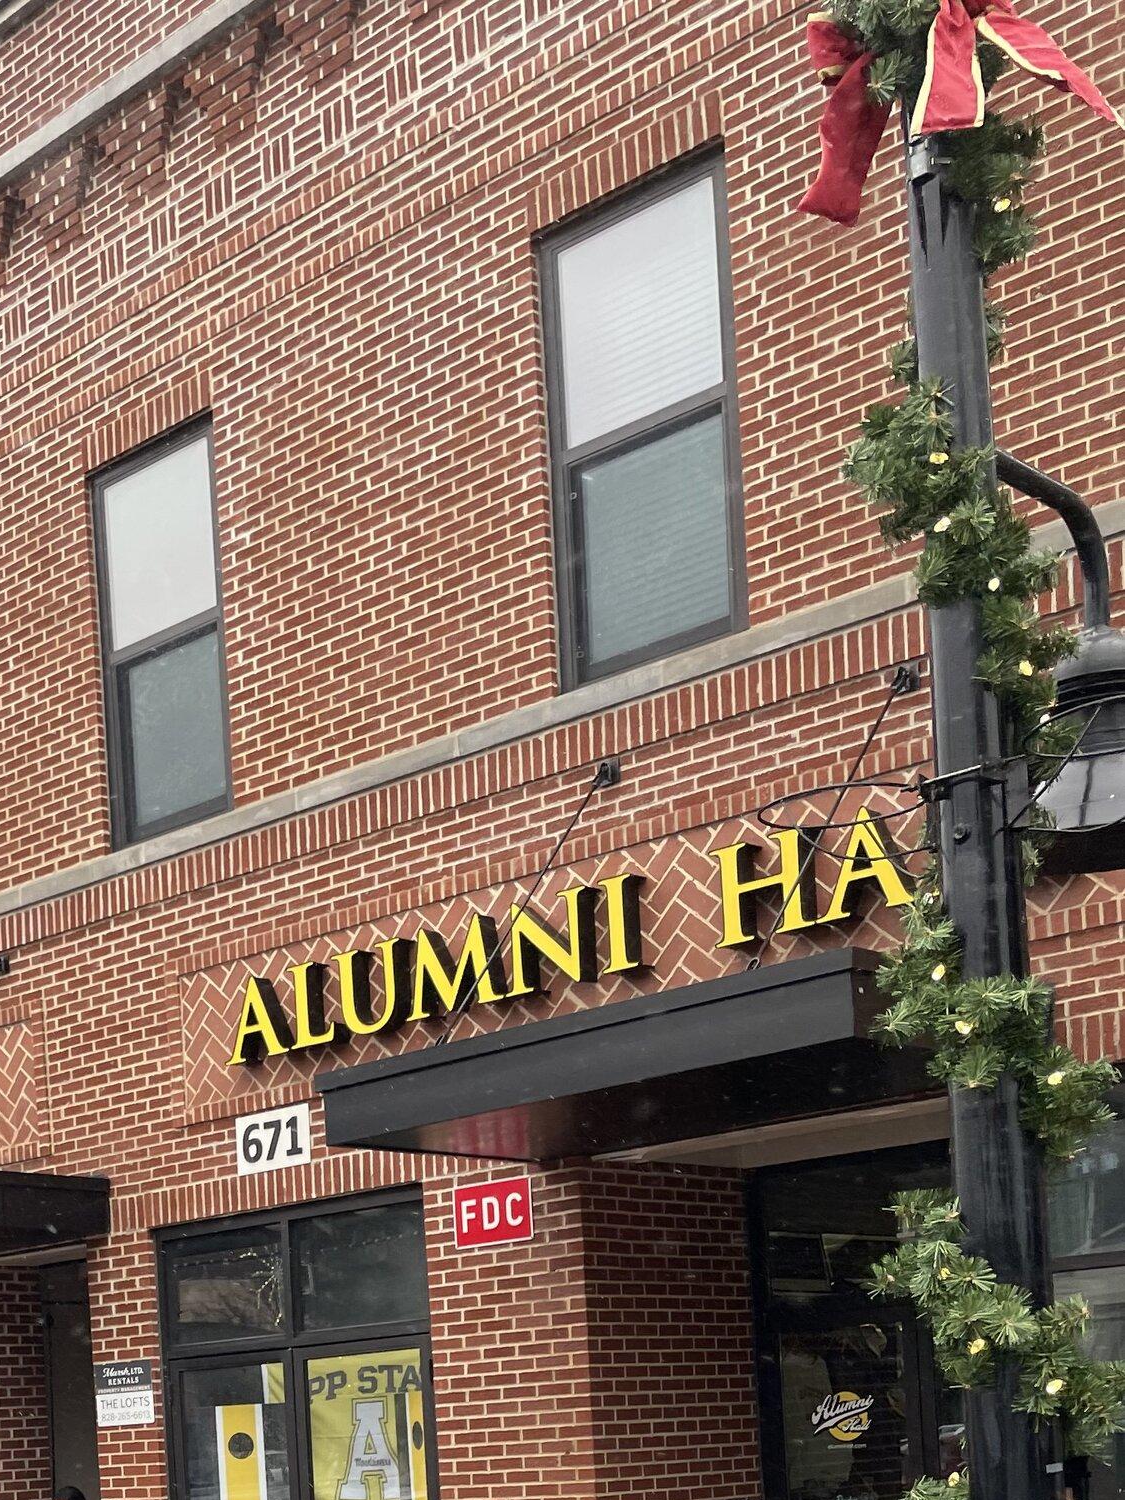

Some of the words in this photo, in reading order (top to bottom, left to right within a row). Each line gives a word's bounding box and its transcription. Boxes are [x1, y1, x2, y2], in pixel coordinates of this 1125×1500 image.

[226, 872, 647, 1067] ALUMNI
[242, 1115, 303, 1164] 671
[461, 1192, 524, 1234] FDC
[108, 1376, 139, 1386] RENTALS
[100, 1399, 118, 1409] THE
[121, 1396, 150, 1408] LOFTS
[812, 1394, 874, 1425] Alumni
